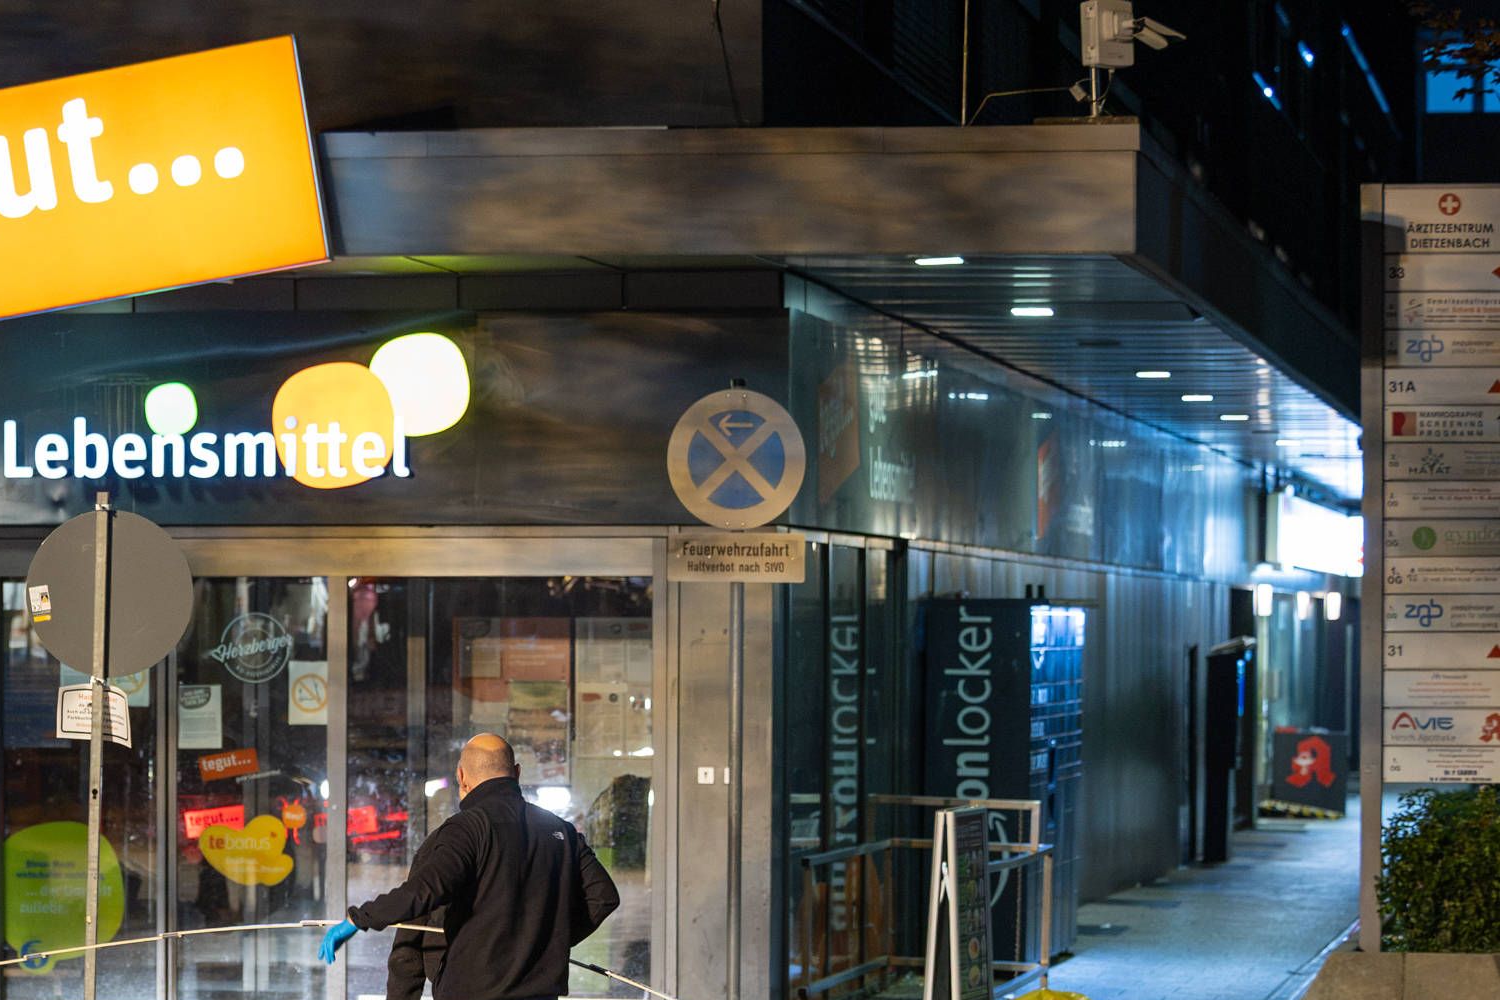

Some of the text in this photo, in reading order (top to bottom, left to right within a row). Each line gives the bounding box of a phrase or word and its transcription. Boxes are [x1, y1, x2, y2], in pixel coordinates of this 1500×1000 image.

[1407, 221, 1494, 233] ÄRZTEZENTRUM
[1410, 238, 1490, 248] DIETZENBACH
[1388, 267, 1405, 279] 33
[1388, 381, 1416, 393] 31A
[3, 416, 411, 480] Lebensmittel
[683, 542, 790, 557] Feuerwehrzufahrt
[687, 560, 785, 573] Haltverbot nach StVO
[1387, 576, 1403, 585] OG
[1387, 645, 1403, 657] 31
[943, 606, 993, 801] onlocker
[202, 754, 252, 772] tegut...
[208, 834, 272, 850] tebonus
